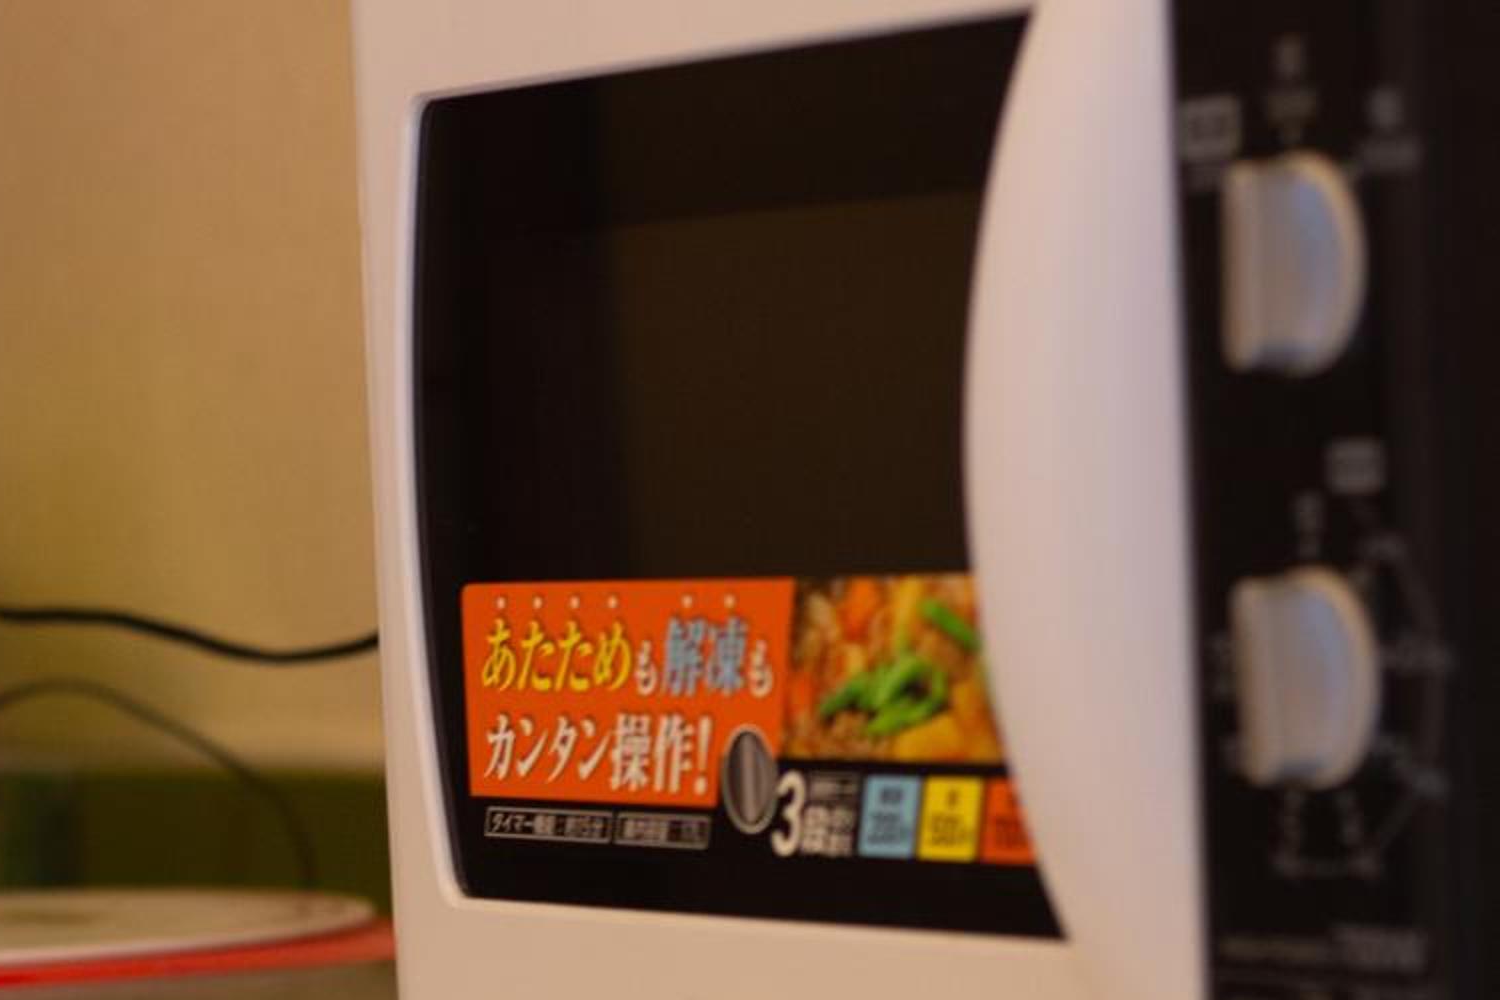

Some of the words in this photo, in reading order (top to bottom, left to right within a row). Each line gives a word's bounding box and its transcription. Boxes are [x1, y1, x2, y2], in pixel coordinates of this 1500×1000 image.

[482, 617, 774, 698] あたためも解凍も
